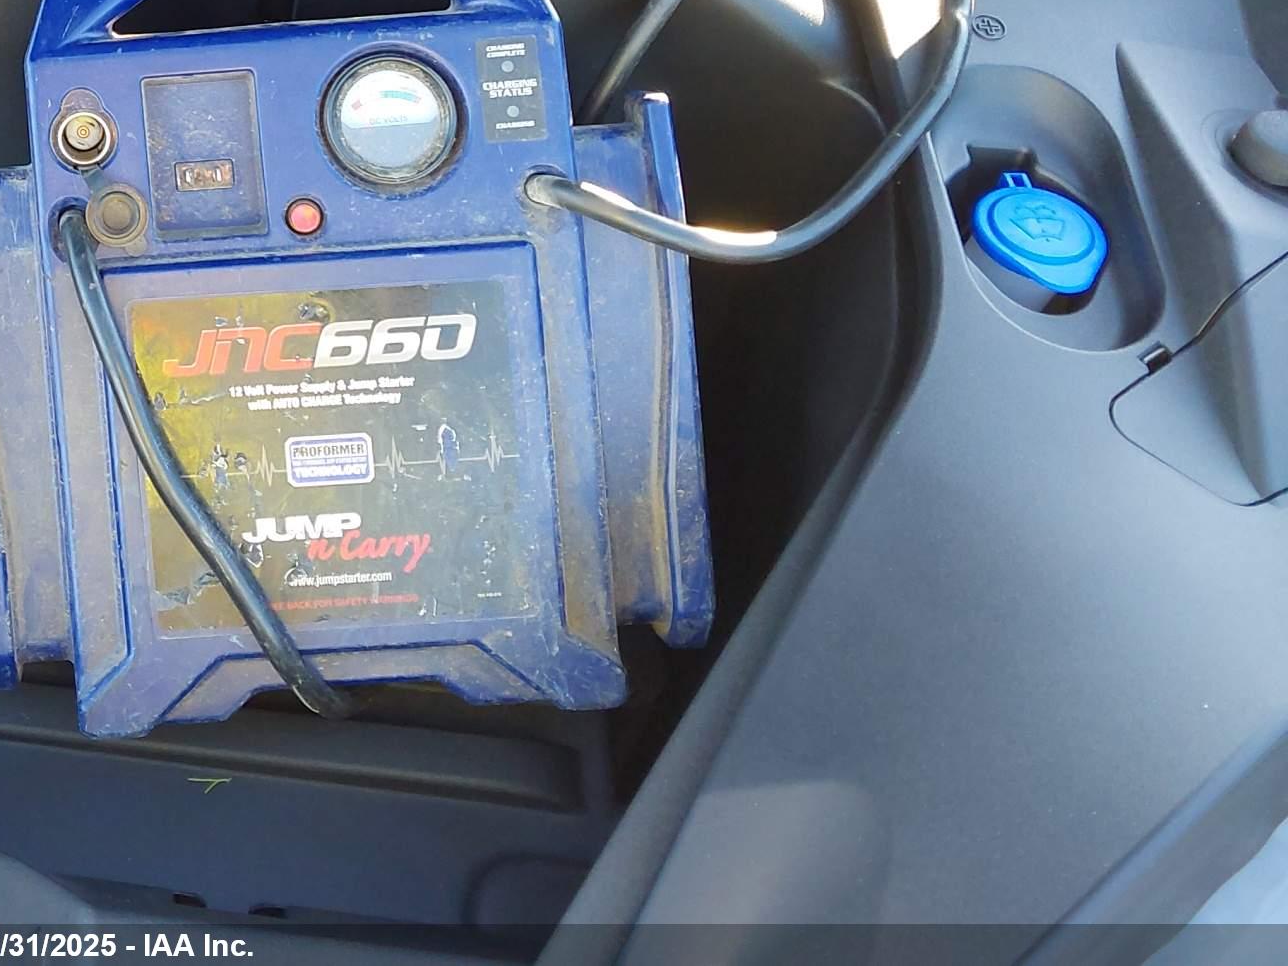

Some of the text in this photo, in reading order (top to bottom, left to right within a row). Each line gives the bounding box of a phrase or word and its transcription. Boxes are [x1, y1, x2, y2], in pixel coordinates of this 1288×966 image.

[482, 78, 538, 91] CHARGING
[489, 87, 533, 99] STATUS
[292, 443, 365, 458] PROFORMER
[241, 512, 362, 544] JUMP
[307, 530, 432, 574] n Carry
[290, 570, 393, 588] www.jumpstarter.com
